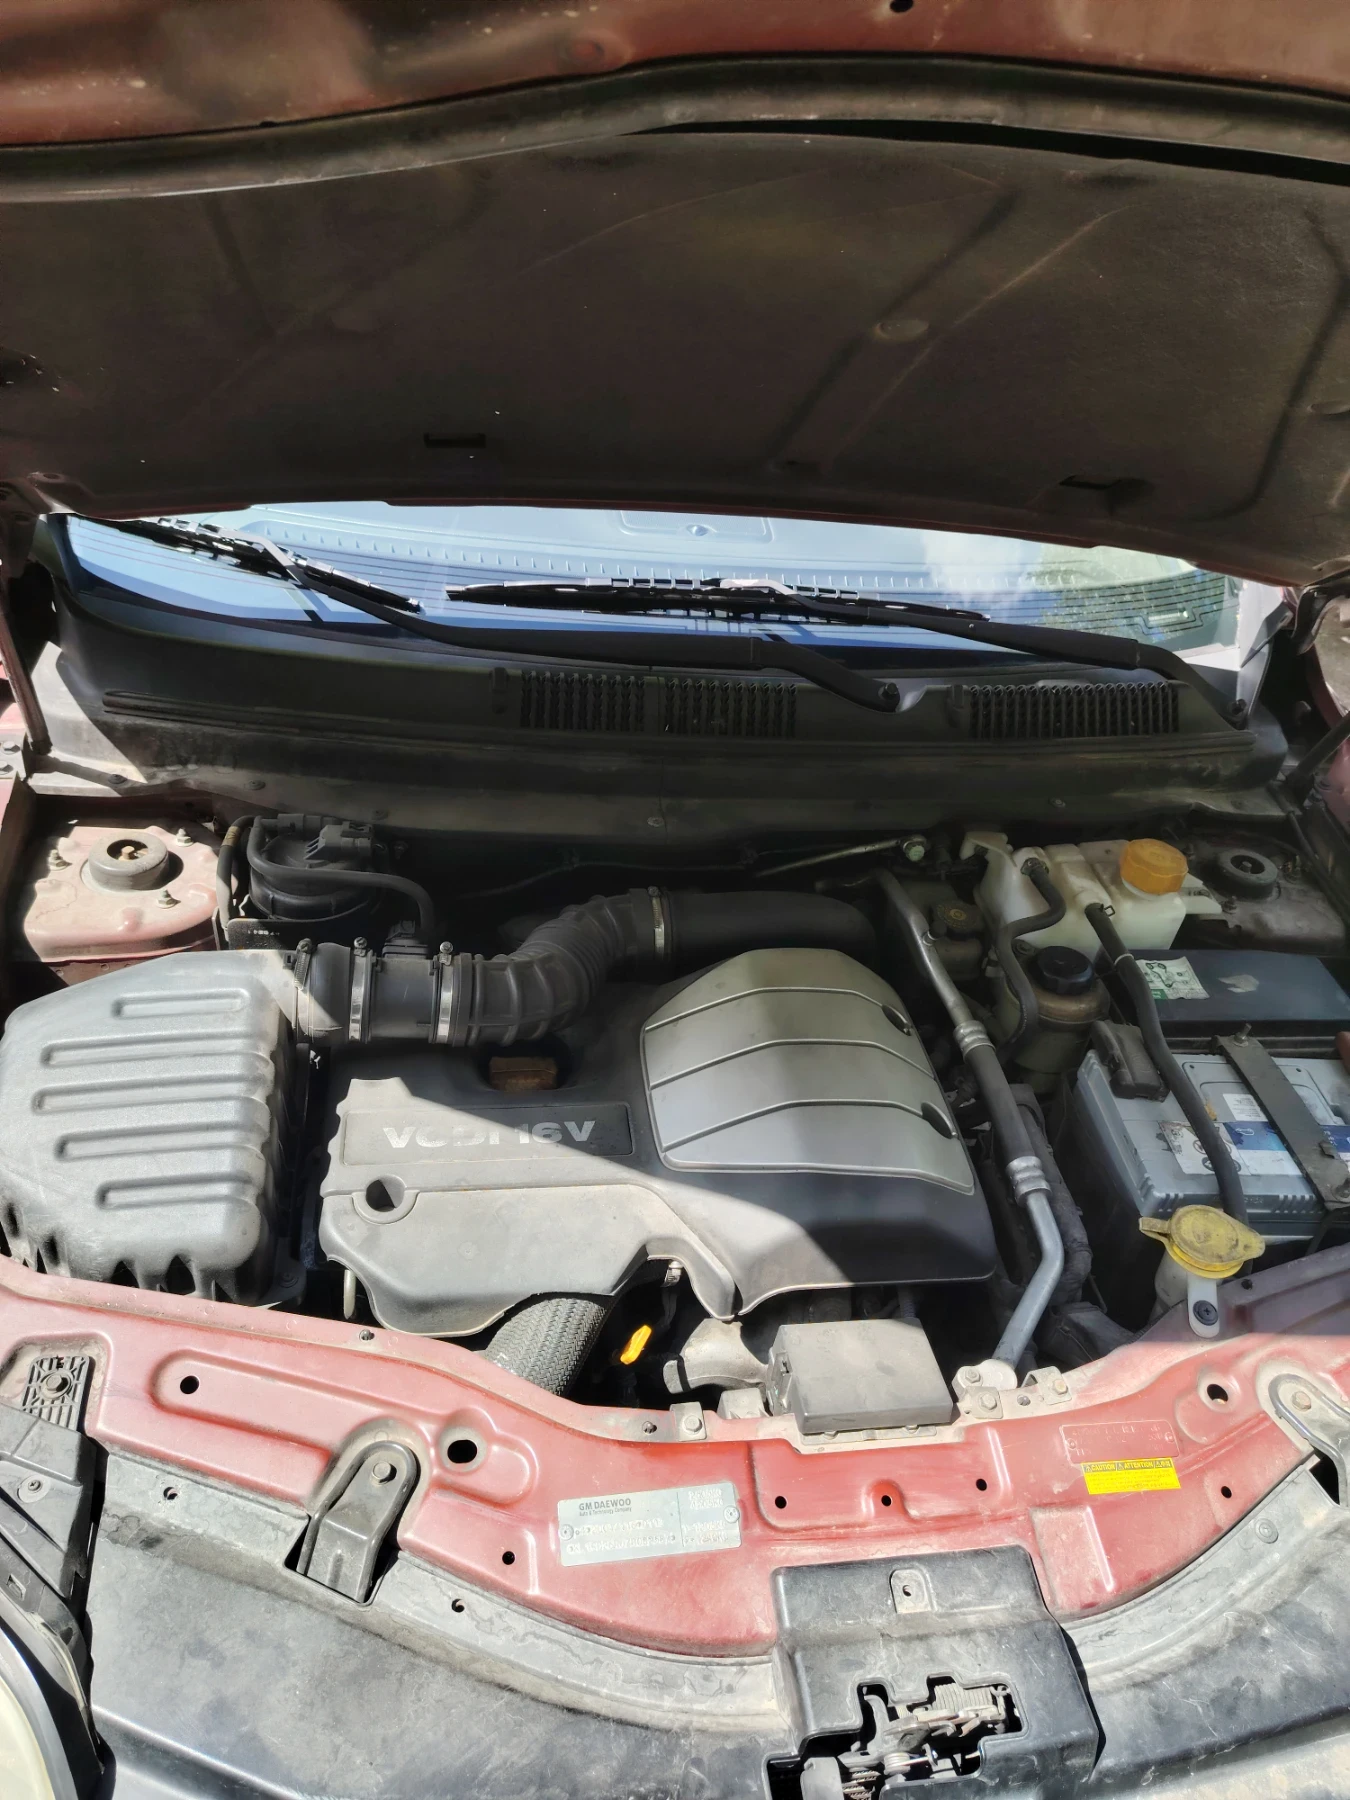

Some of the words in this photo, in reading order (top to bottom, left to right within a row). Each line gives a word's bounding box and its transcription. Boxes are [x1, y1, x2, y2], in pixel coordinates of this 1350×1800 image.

[514, 1121, 596, 1144] 16V
[1091, 1463, 1116, 1471] CAUTION
[1124, 1461, 1154, 1470] ATTENTION
[578, 1502, 593, 1511] GM
[594, 1498, 632, 1510] DAEWOO
